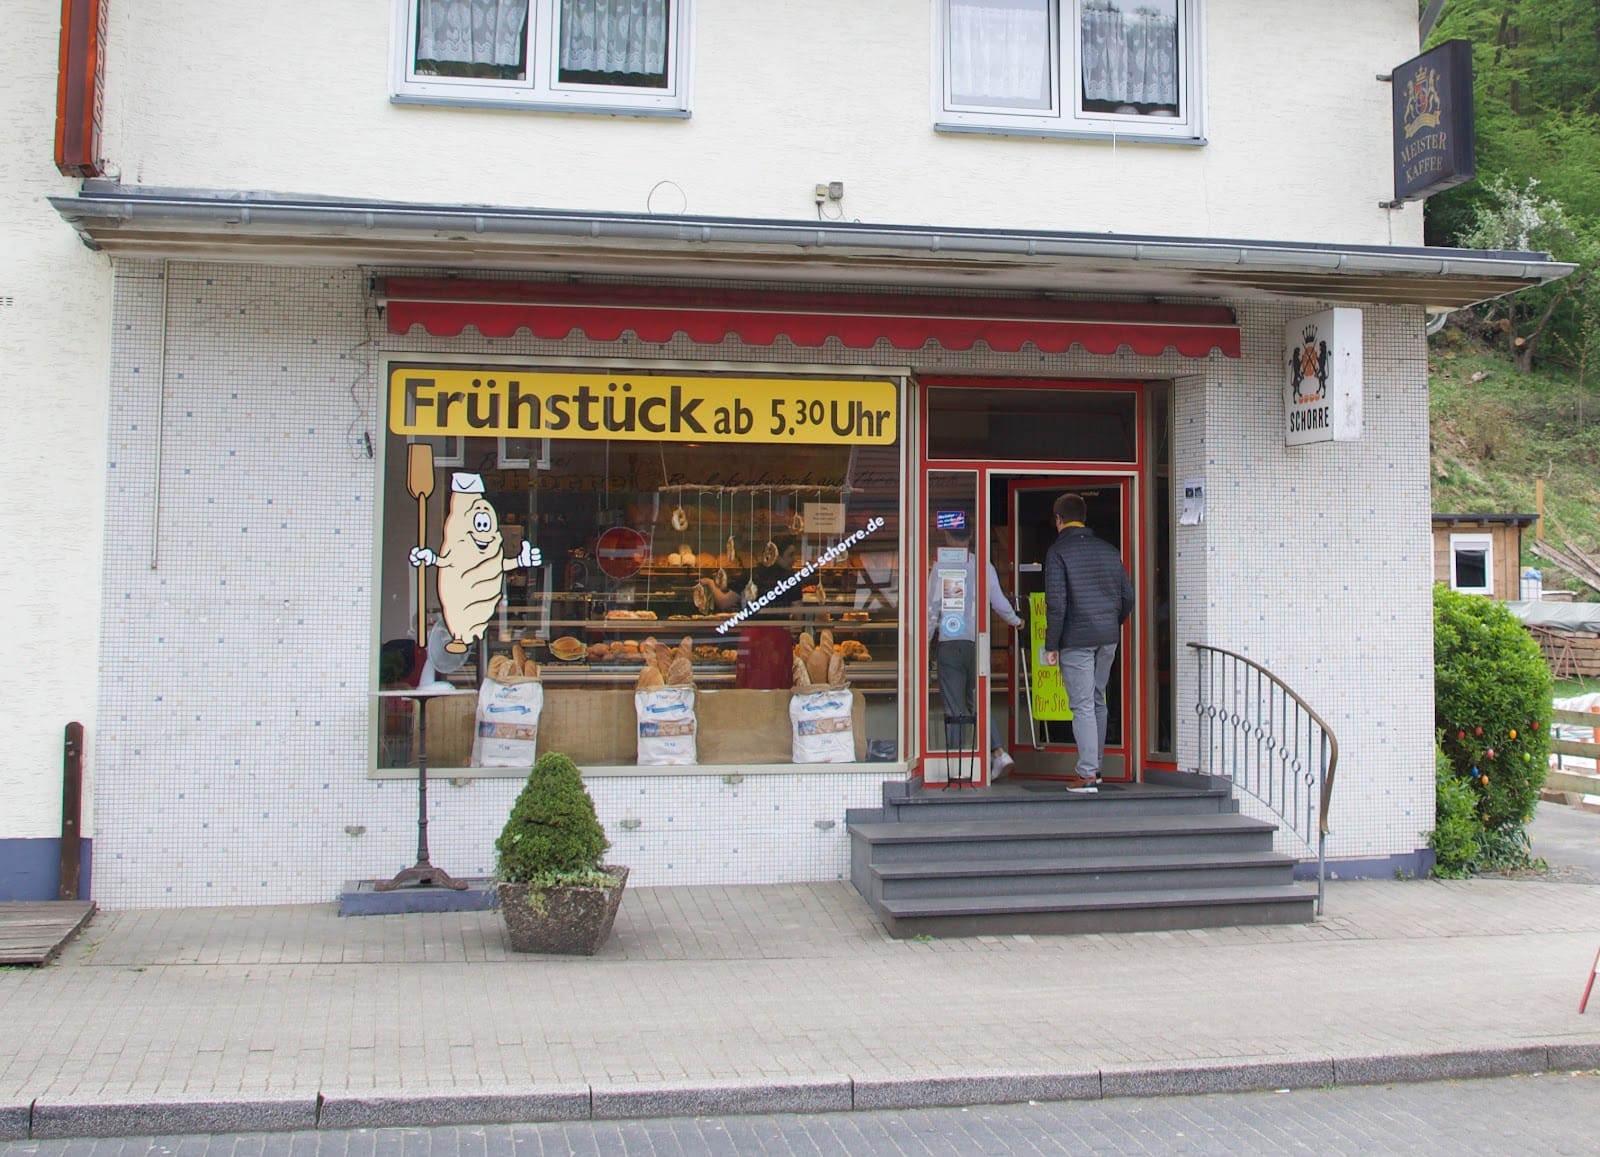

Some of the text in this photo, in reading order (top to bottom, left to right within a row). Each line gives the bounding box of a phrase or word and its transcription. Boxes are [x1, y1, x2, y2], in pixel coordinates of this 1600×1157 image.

[1400, 131, 1447, 166] MEISTER
[1405, 155, 1444, 184] KAFFEE
[404, 378, 707, 432] Frühstück
[713, 398, 754, 434] ab
[830, 400, 890, 437] Uhr
[1290, 406, 1329, 433] SCHORRE
[715, 516, 885, 635] www.baeckerei-schorre.de
[1034, 693, 1066, 713] für Sie
